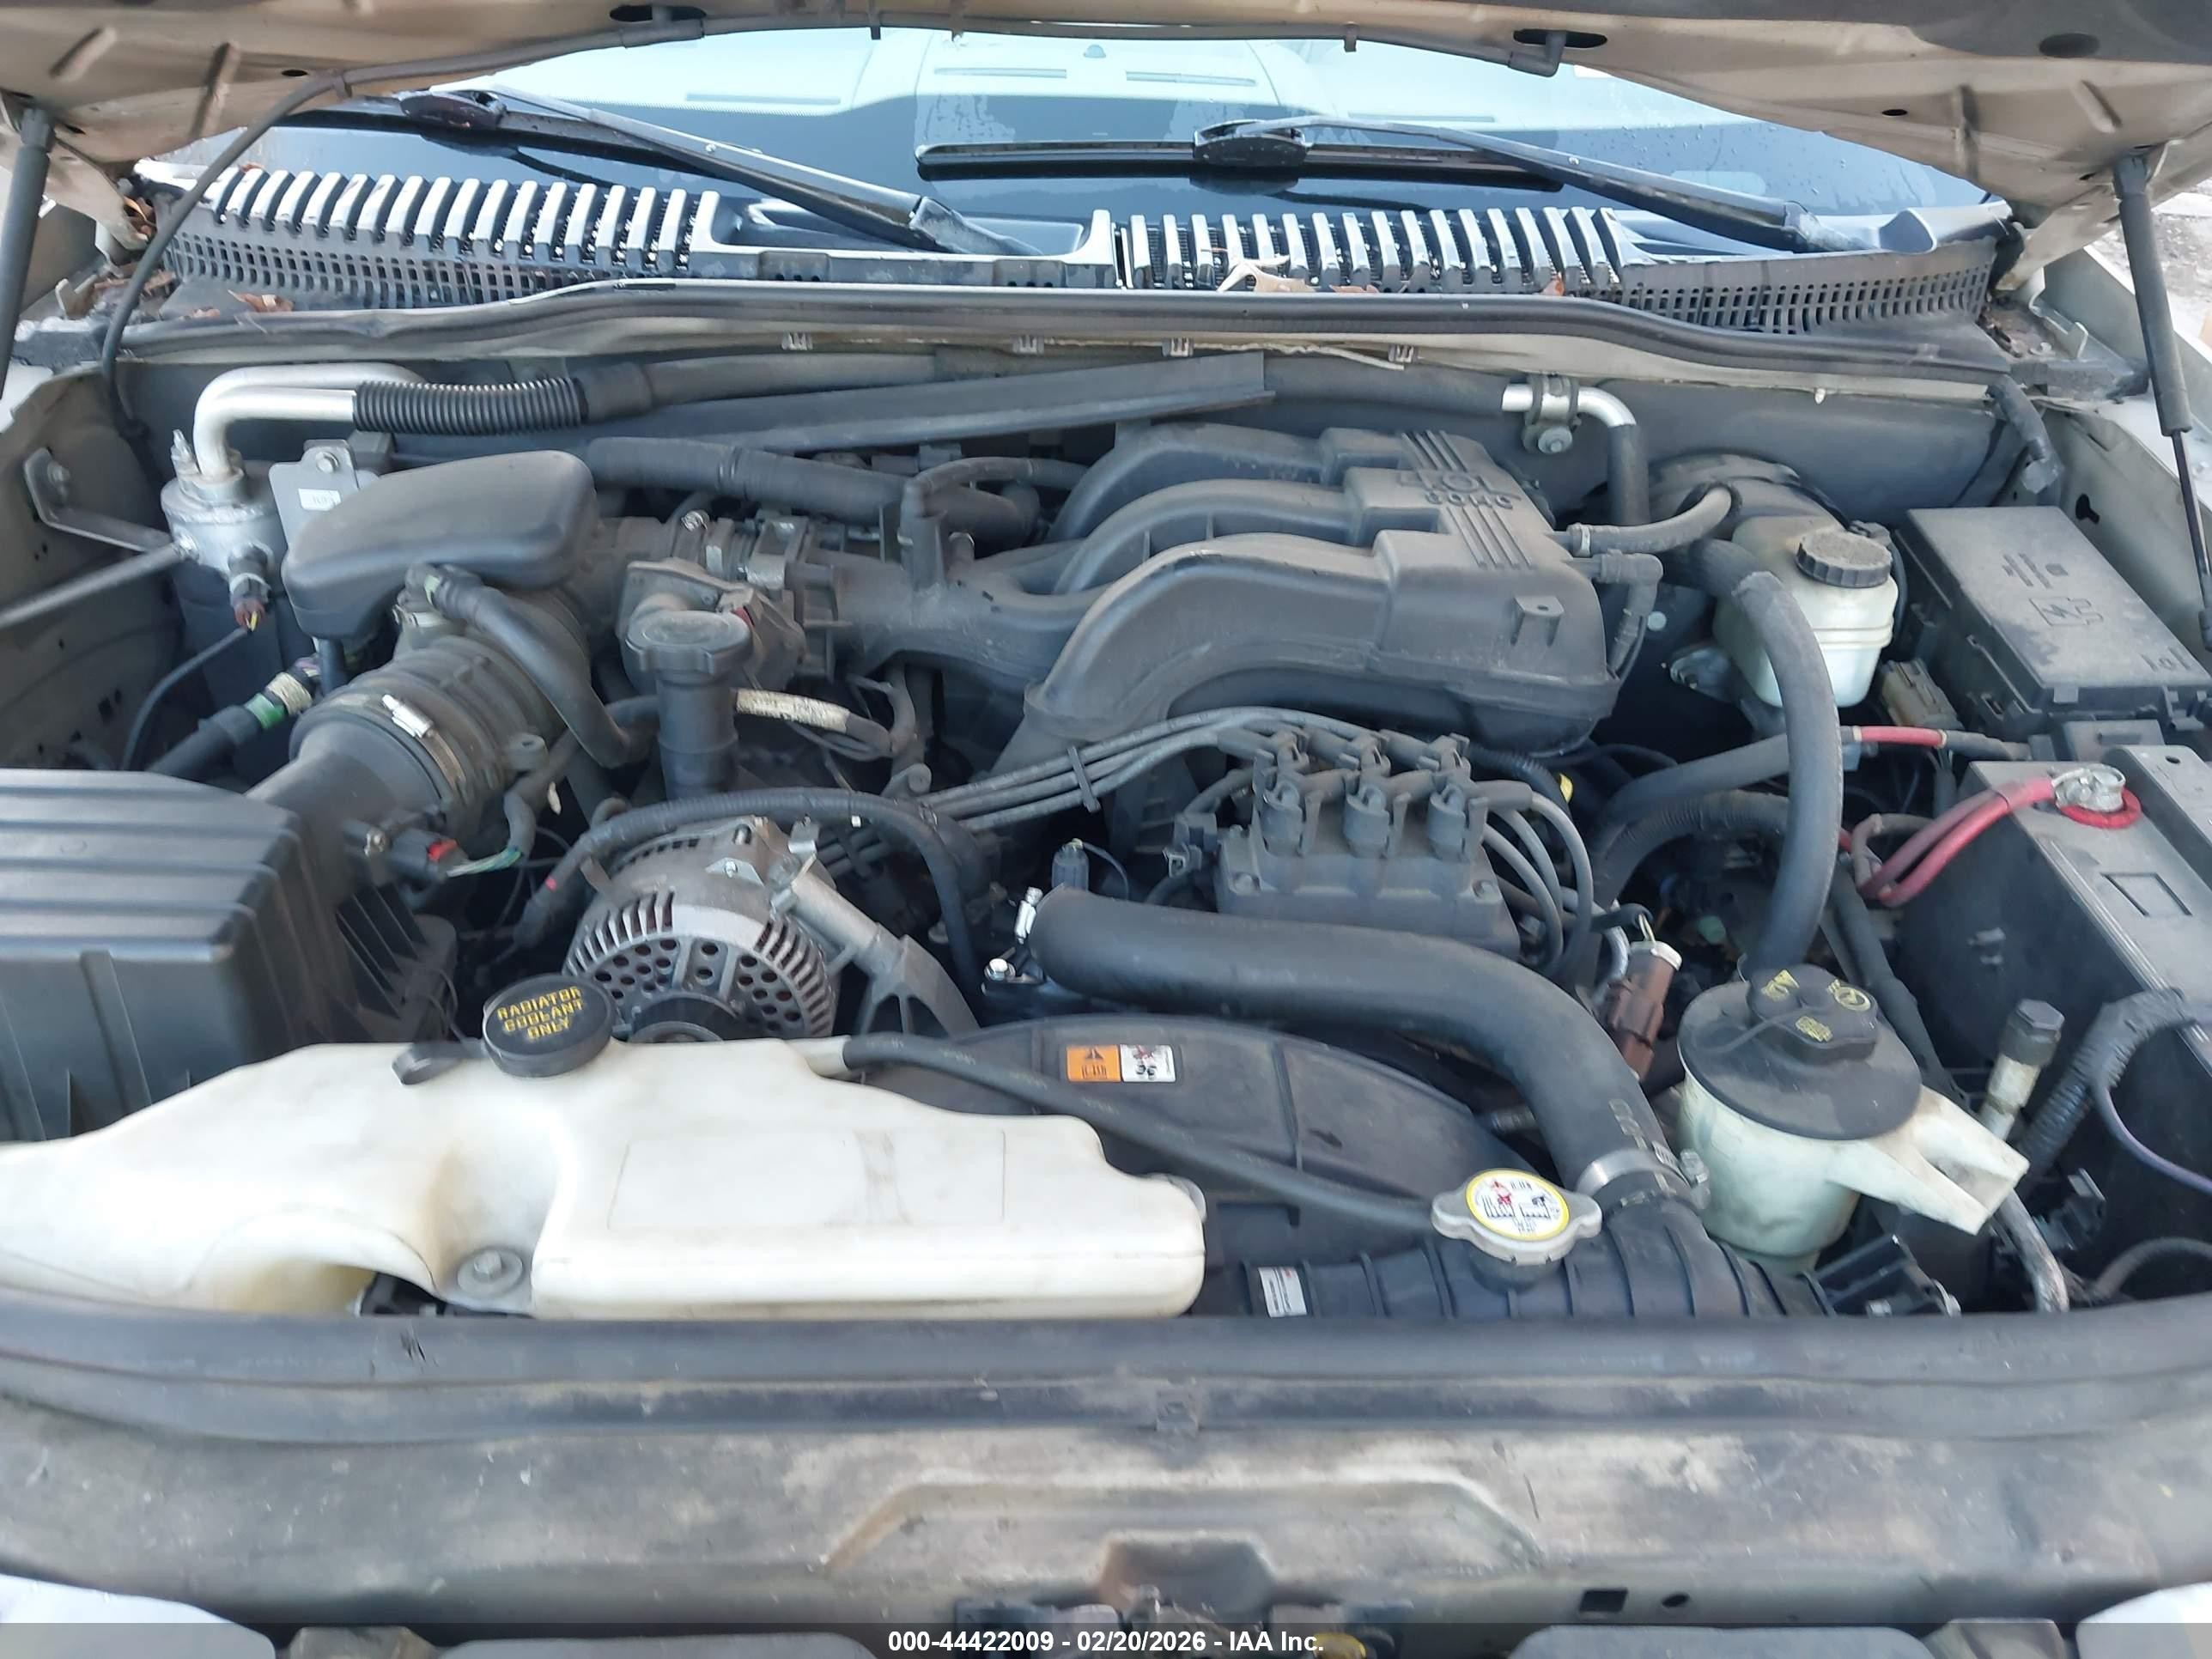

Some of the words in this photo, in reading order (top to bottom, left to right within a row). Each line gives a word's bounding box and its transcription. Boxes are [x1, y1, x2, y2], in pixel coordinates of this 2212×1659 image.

[497, 986, 581, 1021] RADIATOR
[504, 999, 582, 1032] COOLANT
[527, 1017, 569, 1040] ONLY
